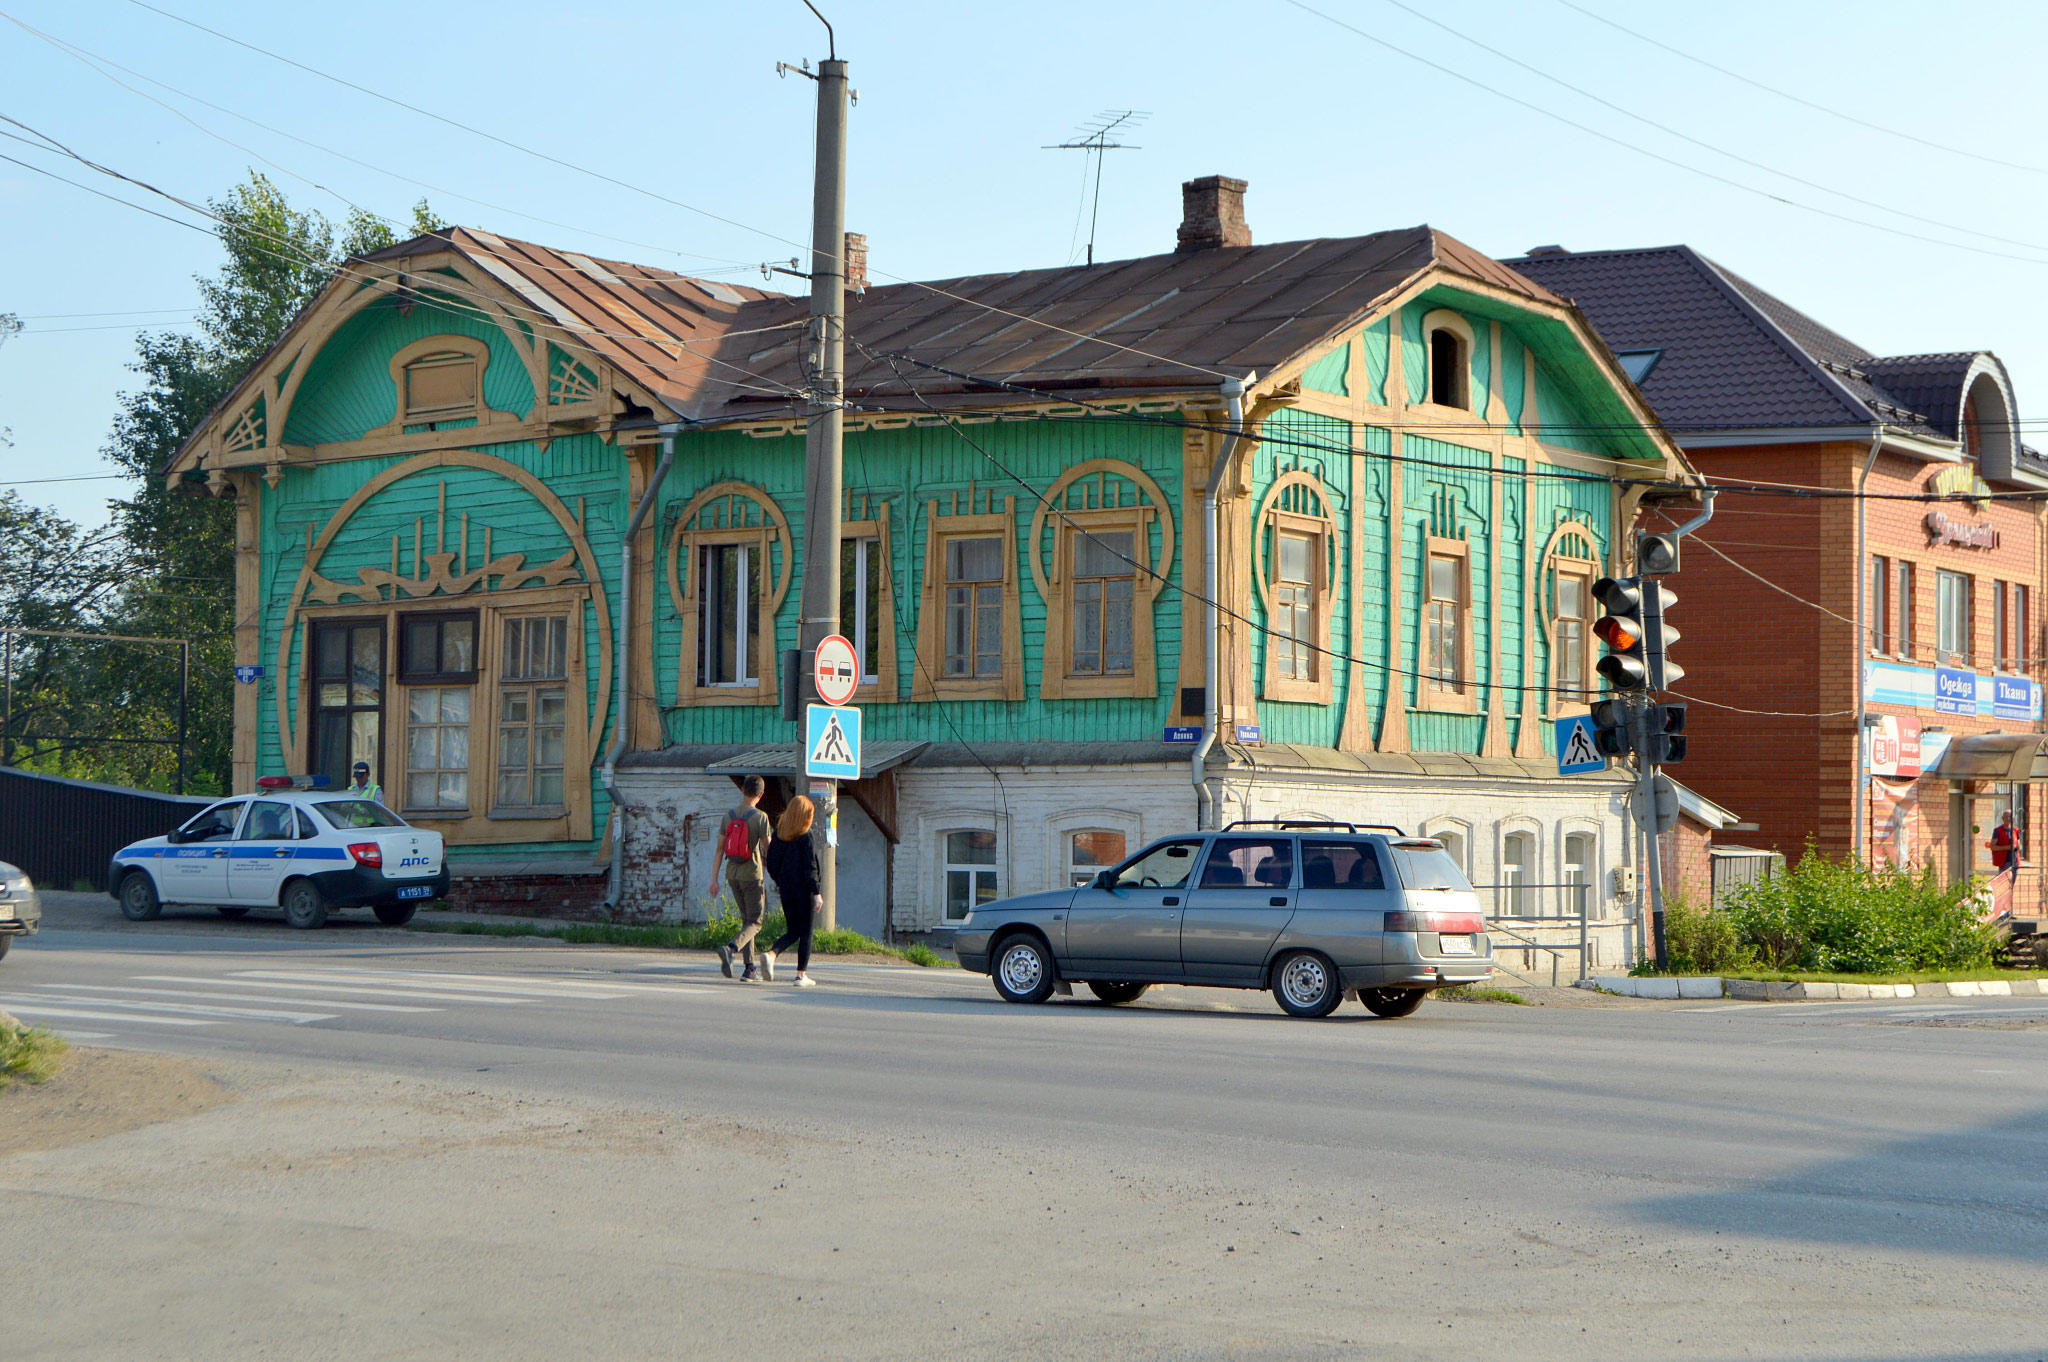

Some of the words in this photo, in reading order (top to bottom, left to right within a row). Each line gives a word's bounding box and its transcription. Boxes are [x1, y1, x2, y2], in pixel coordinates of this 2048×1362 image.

[1940, 674, 1972, 698] Одежда
[1998, 682, 2027, 701] Ткани
[177, 849, 207, 857] ПОЛИЦИЯ
[400, 857, 430, 867] ДПС
[407, 888, 421, 897] 1151
